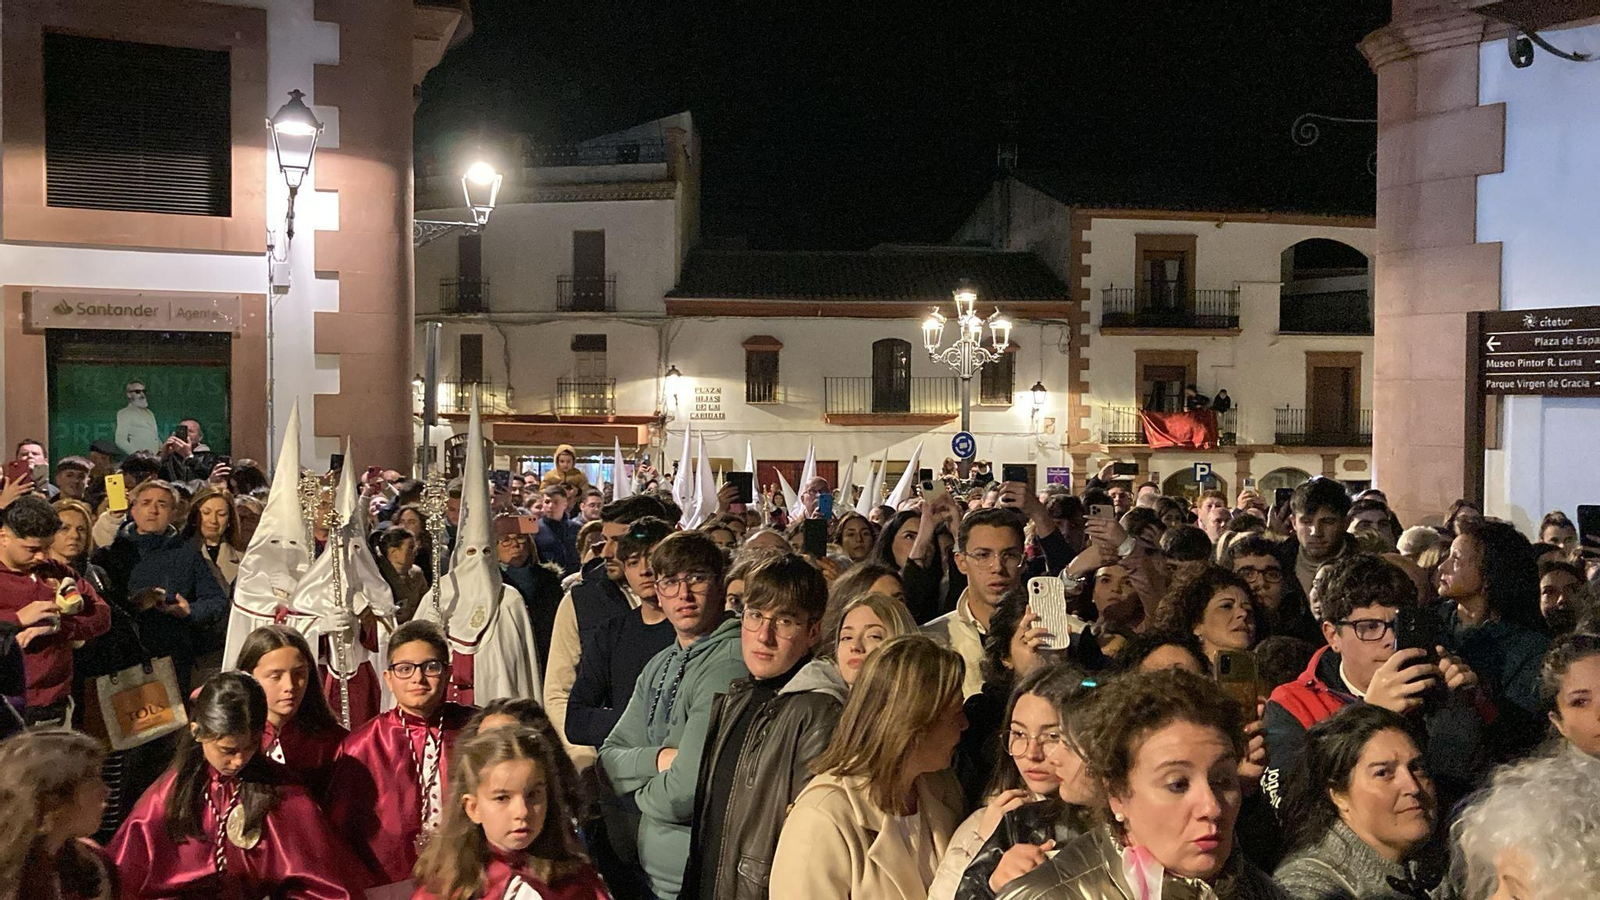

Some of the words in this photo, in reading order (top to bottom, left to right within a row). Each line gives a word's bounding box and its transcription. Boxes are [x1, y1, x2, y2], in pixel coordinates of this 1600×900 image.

[76, 301, 159, 317] Santander
[1539, 315, 1573, 327] citetur
[1534, 336, 1560, 346] Plaza
[1562, 335, 1574, 345] de
[1485, 358, 1516, 368] Museo
[1517, 358, 1545, 367] Pintor
[1547, 358, 1556, 367] R.
[1558, 357, 1582, 367] Luna
[1485, 379, 1515, 390] Parque
[1516, 379, 1545, 390] Virgen
[1547, 379, 1559, 388] de
[1560, 378, 1590, 388] Gracia
[694, 387, 722, 395] PLAZA
[695, 395, 721, 403] HIJAS
[695, 404, 707, 412] DE
[708, 404, 721, 412] LA
[690, 412, 726, 421] CARIDAD
[1195, 464, 1210, 481] P
